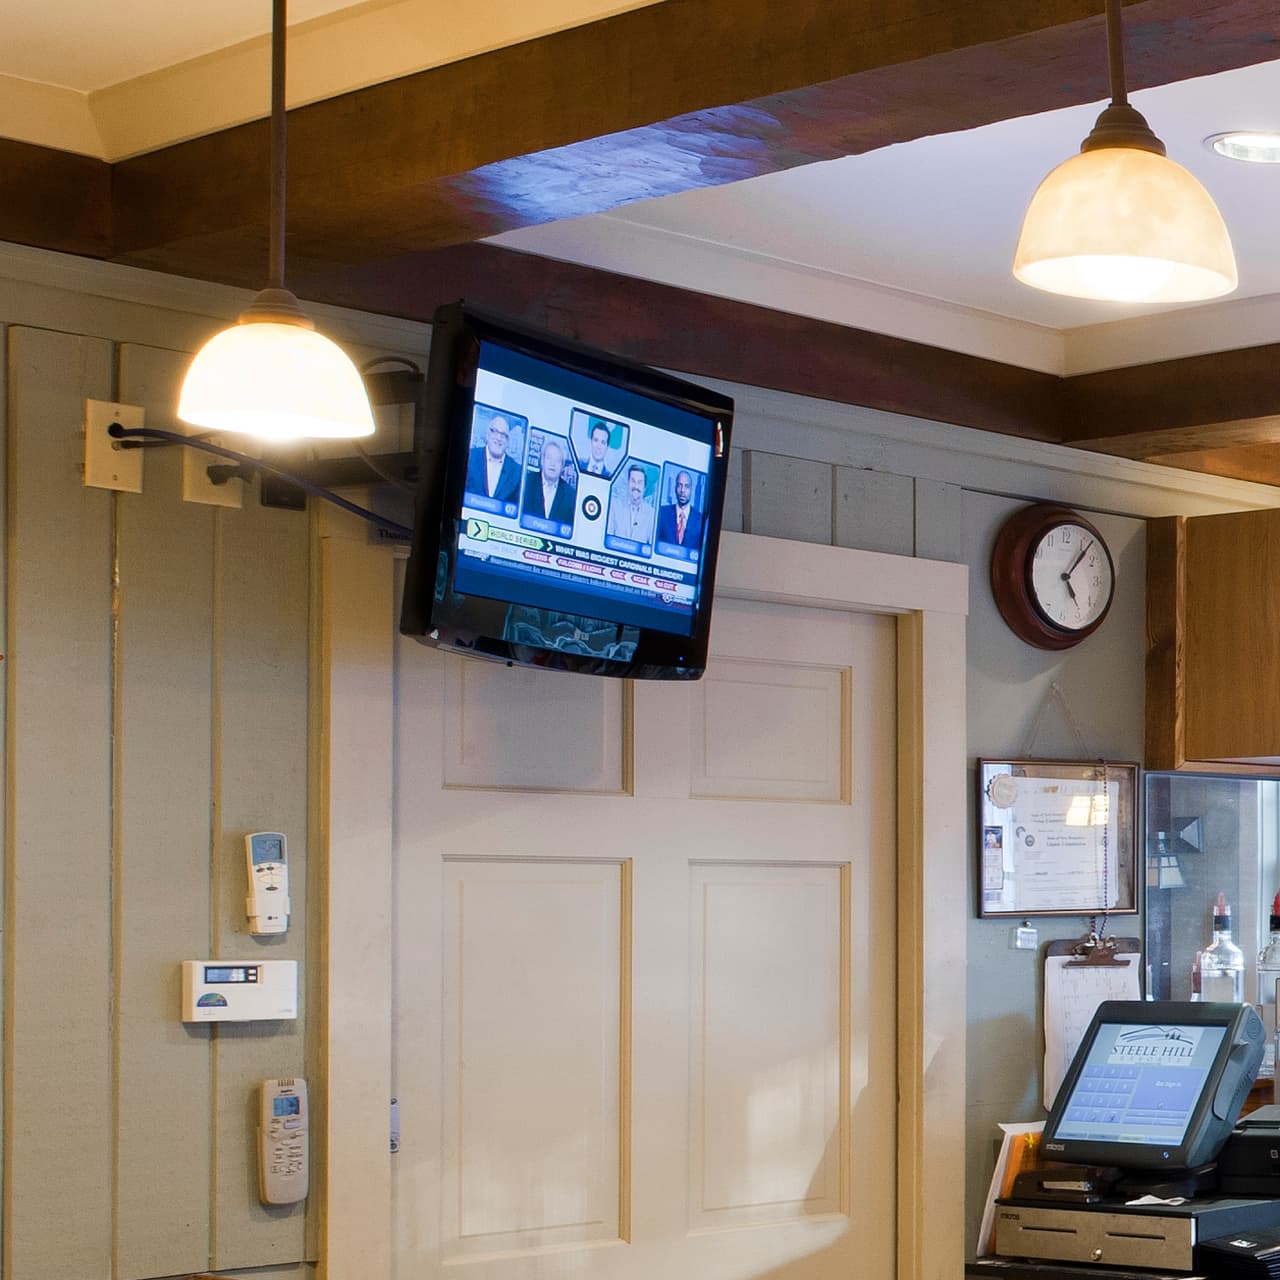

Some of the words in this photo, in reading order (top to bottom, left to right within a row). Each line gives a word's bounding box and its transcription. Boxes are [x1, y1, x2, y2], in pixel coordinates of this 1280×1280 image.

[1062, 531, 1071, 544] 12
[1111, 1044, 1158, 1057] STEELE
[1161, 1046, 1194, 1058] HILL
